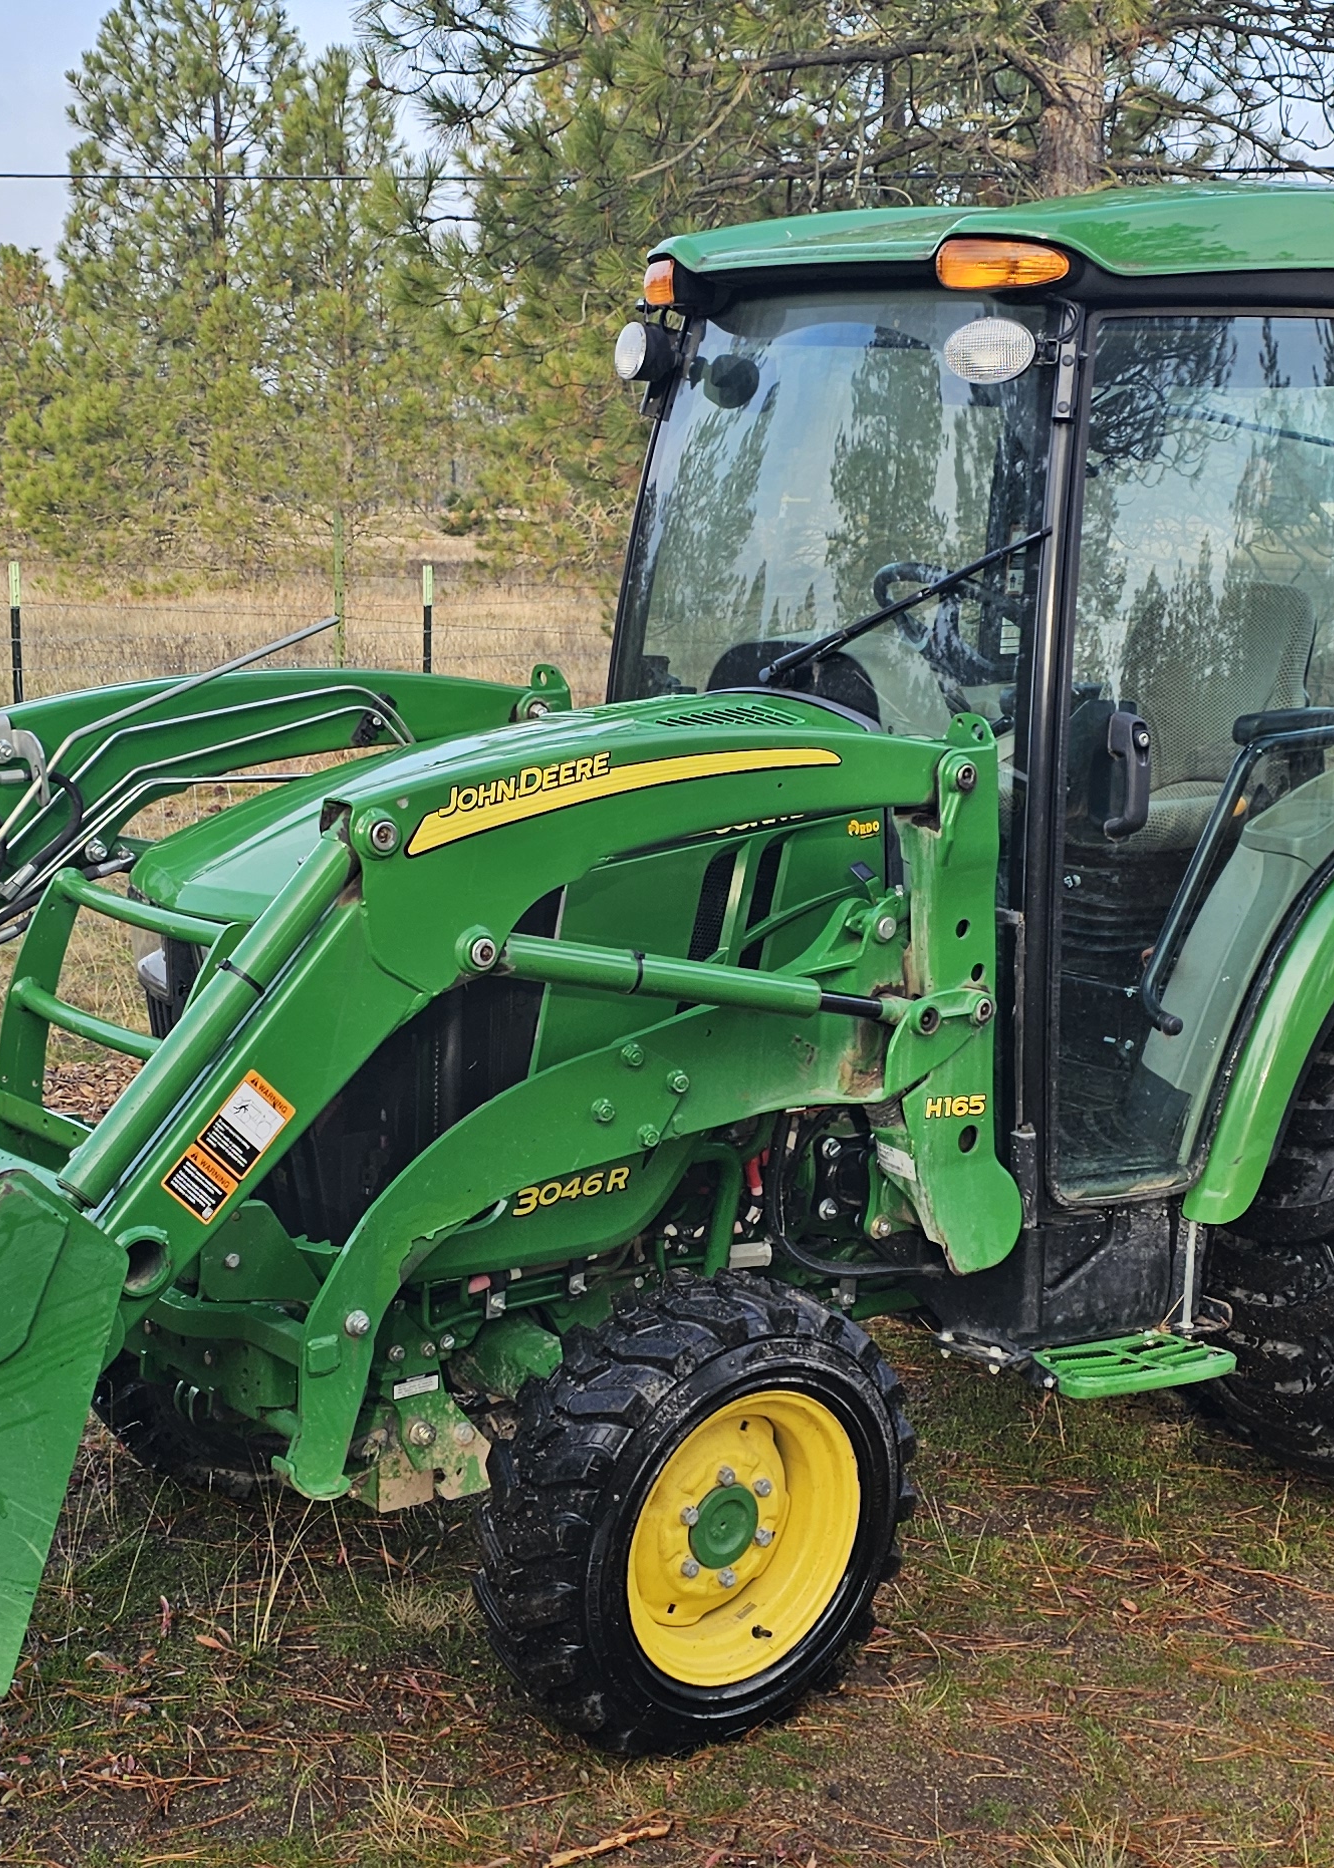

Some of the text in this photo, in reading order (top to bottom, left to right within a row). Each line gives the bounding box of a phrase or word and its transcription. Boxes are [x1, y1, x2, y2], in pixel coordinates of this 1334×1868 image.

[438, 752, 610, 817] JOHN DEERE
[258, 1084, 289, 1114] WARNING
[925, 1094, 986, 1119] H165
[199, 1158, 230, 1189] WARNING
